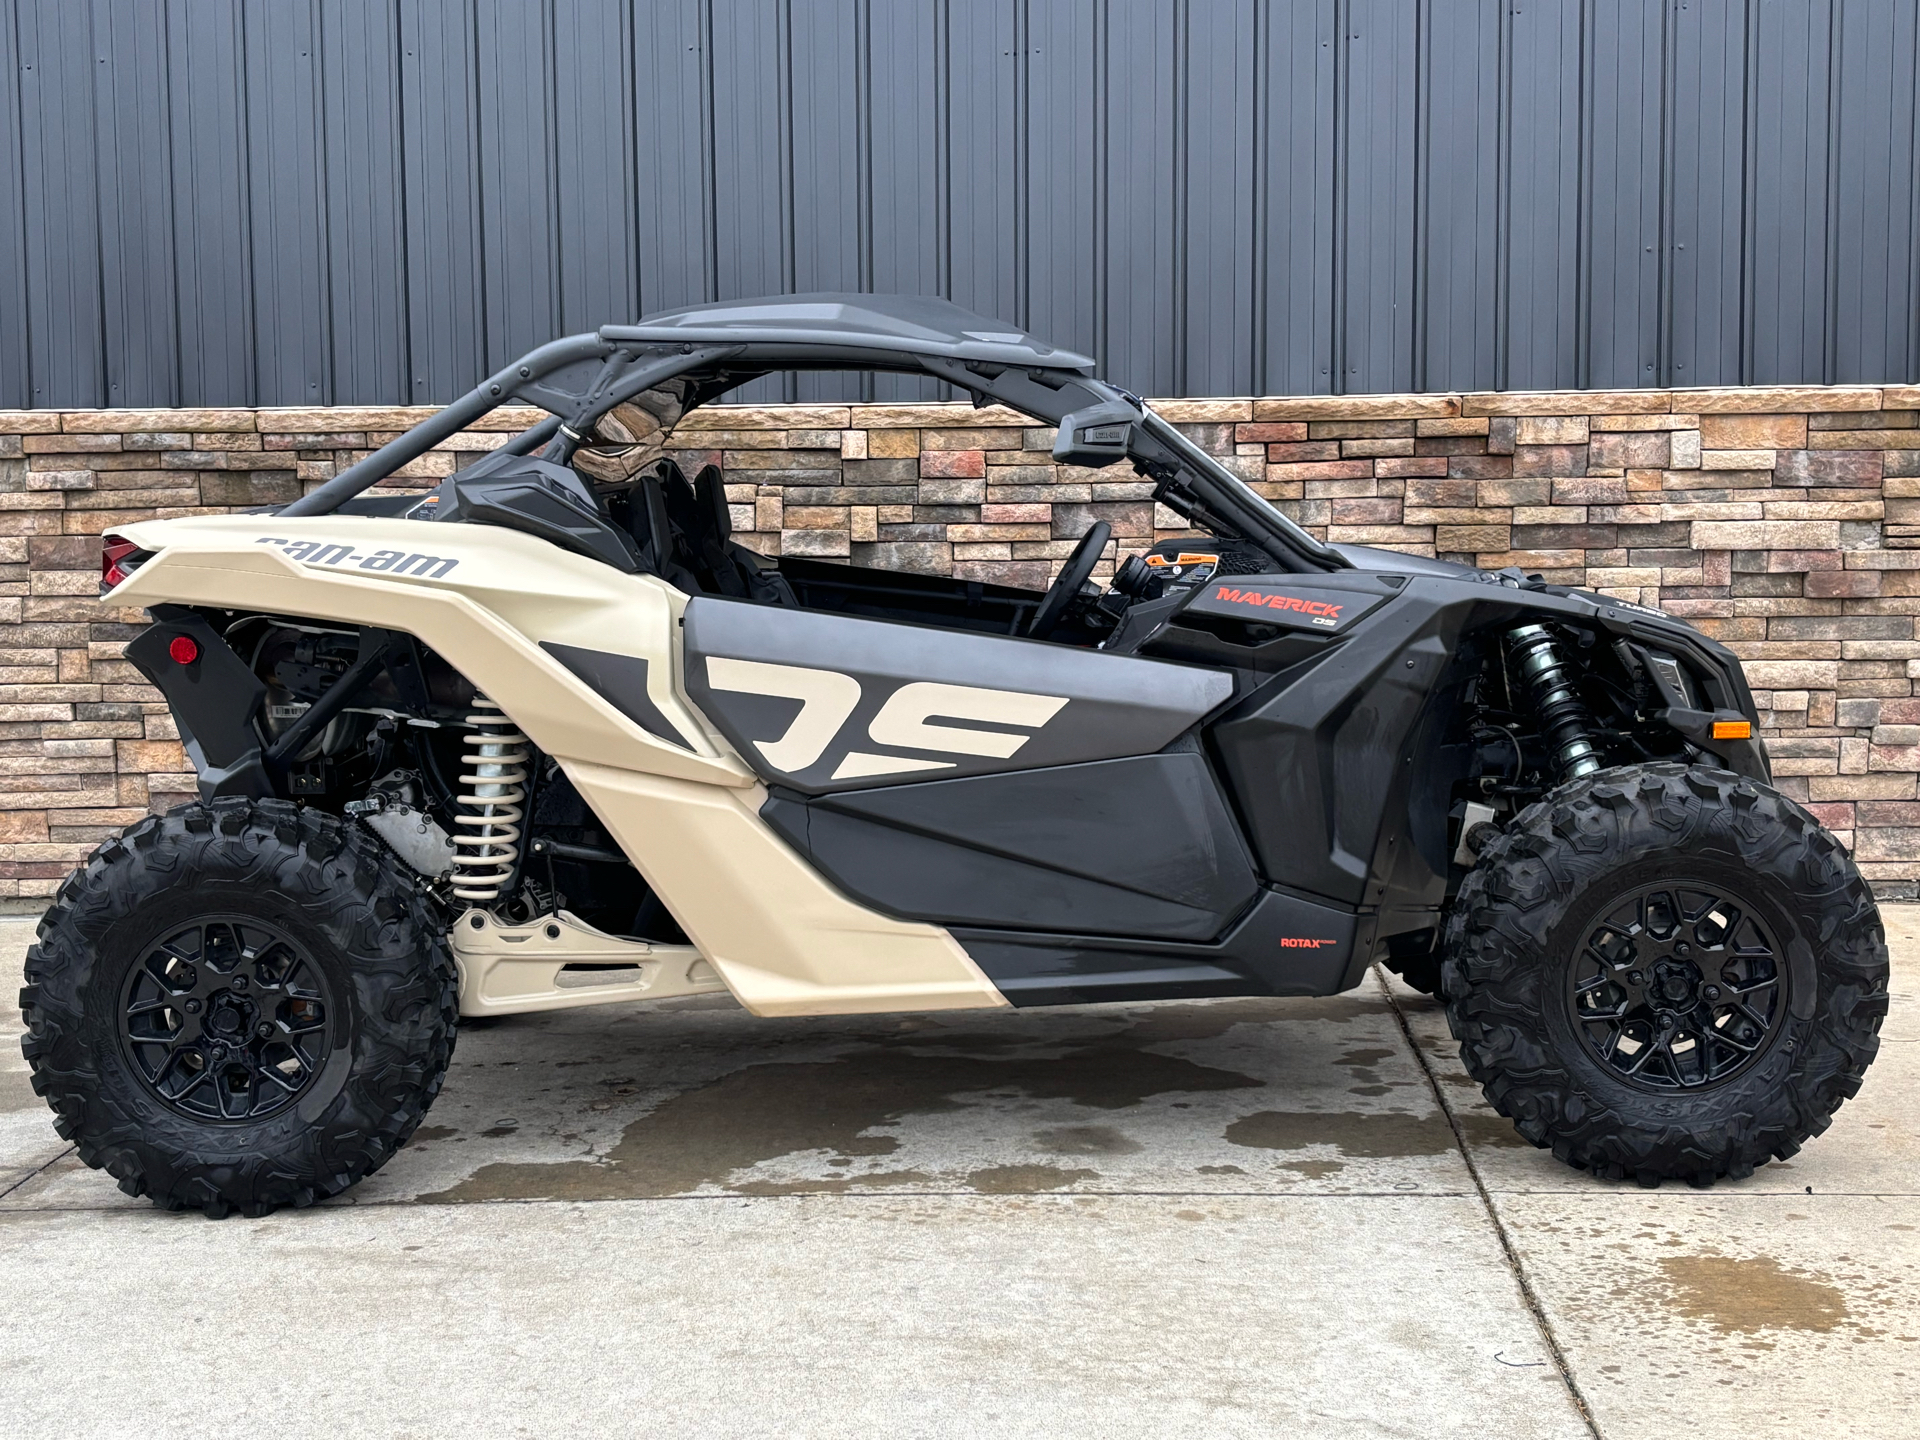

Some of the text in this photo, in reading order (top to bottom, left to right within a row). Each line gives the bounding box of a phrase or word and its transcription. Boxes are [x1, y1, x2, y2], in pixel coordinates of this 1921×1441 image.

[1216, 587, 1343, 618] MAVERICK
[1312, 617, 1337, 626] DS
[705, 655, 1071, 780] DS
[1281, 938, 1320, 948] ROTAX
